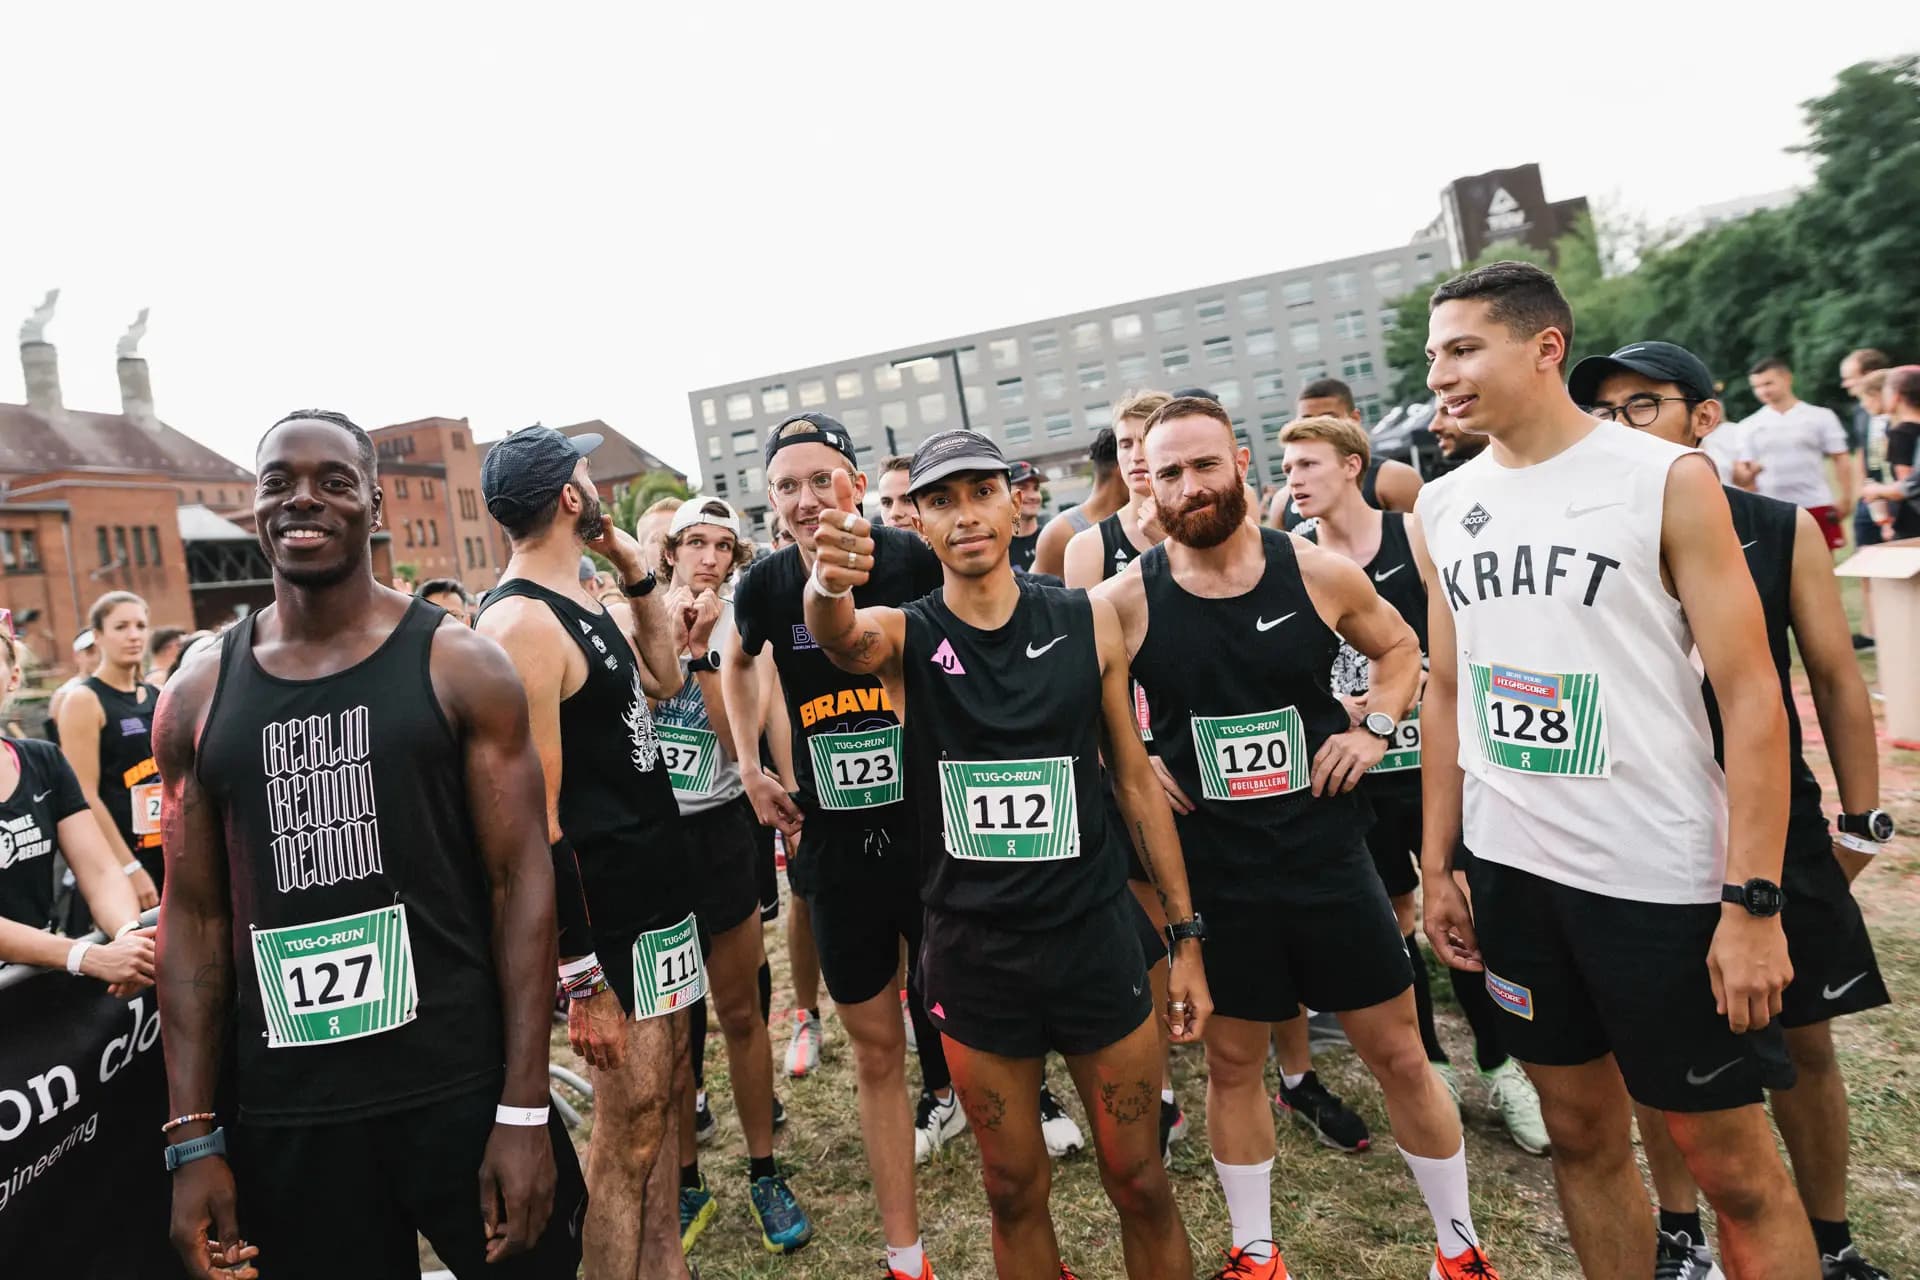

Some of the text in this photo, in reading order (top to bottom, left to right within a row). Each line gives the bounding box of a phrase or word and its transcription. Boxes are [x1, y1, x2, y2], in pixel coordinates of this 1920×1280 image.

[1442, 545, 1621, 612] KRAFT
[1497, 677, 1550, 696] HIGHSCORE
[1220, 719, 1280, 735] TUG-O-RUN
[1491, 701, 1569, 744] 128
[834, 737, 885, 750] TUG-O-RUN
[1222, 739, 1288, 774] 120
[836, 754, 894, 786] 123
[972, 771, 1042, 782] TUG-O-RUN
[1231, 776, 1287, 791] #GEILBALLERN
[973, 793, 1049, 829] 112
[285, 928, 365, 952] TUG-O-RUN
[289, 954, 373, 1008] 127
[661, 945, 698, 988] 111
[0, 1064, 81, 1142] on
